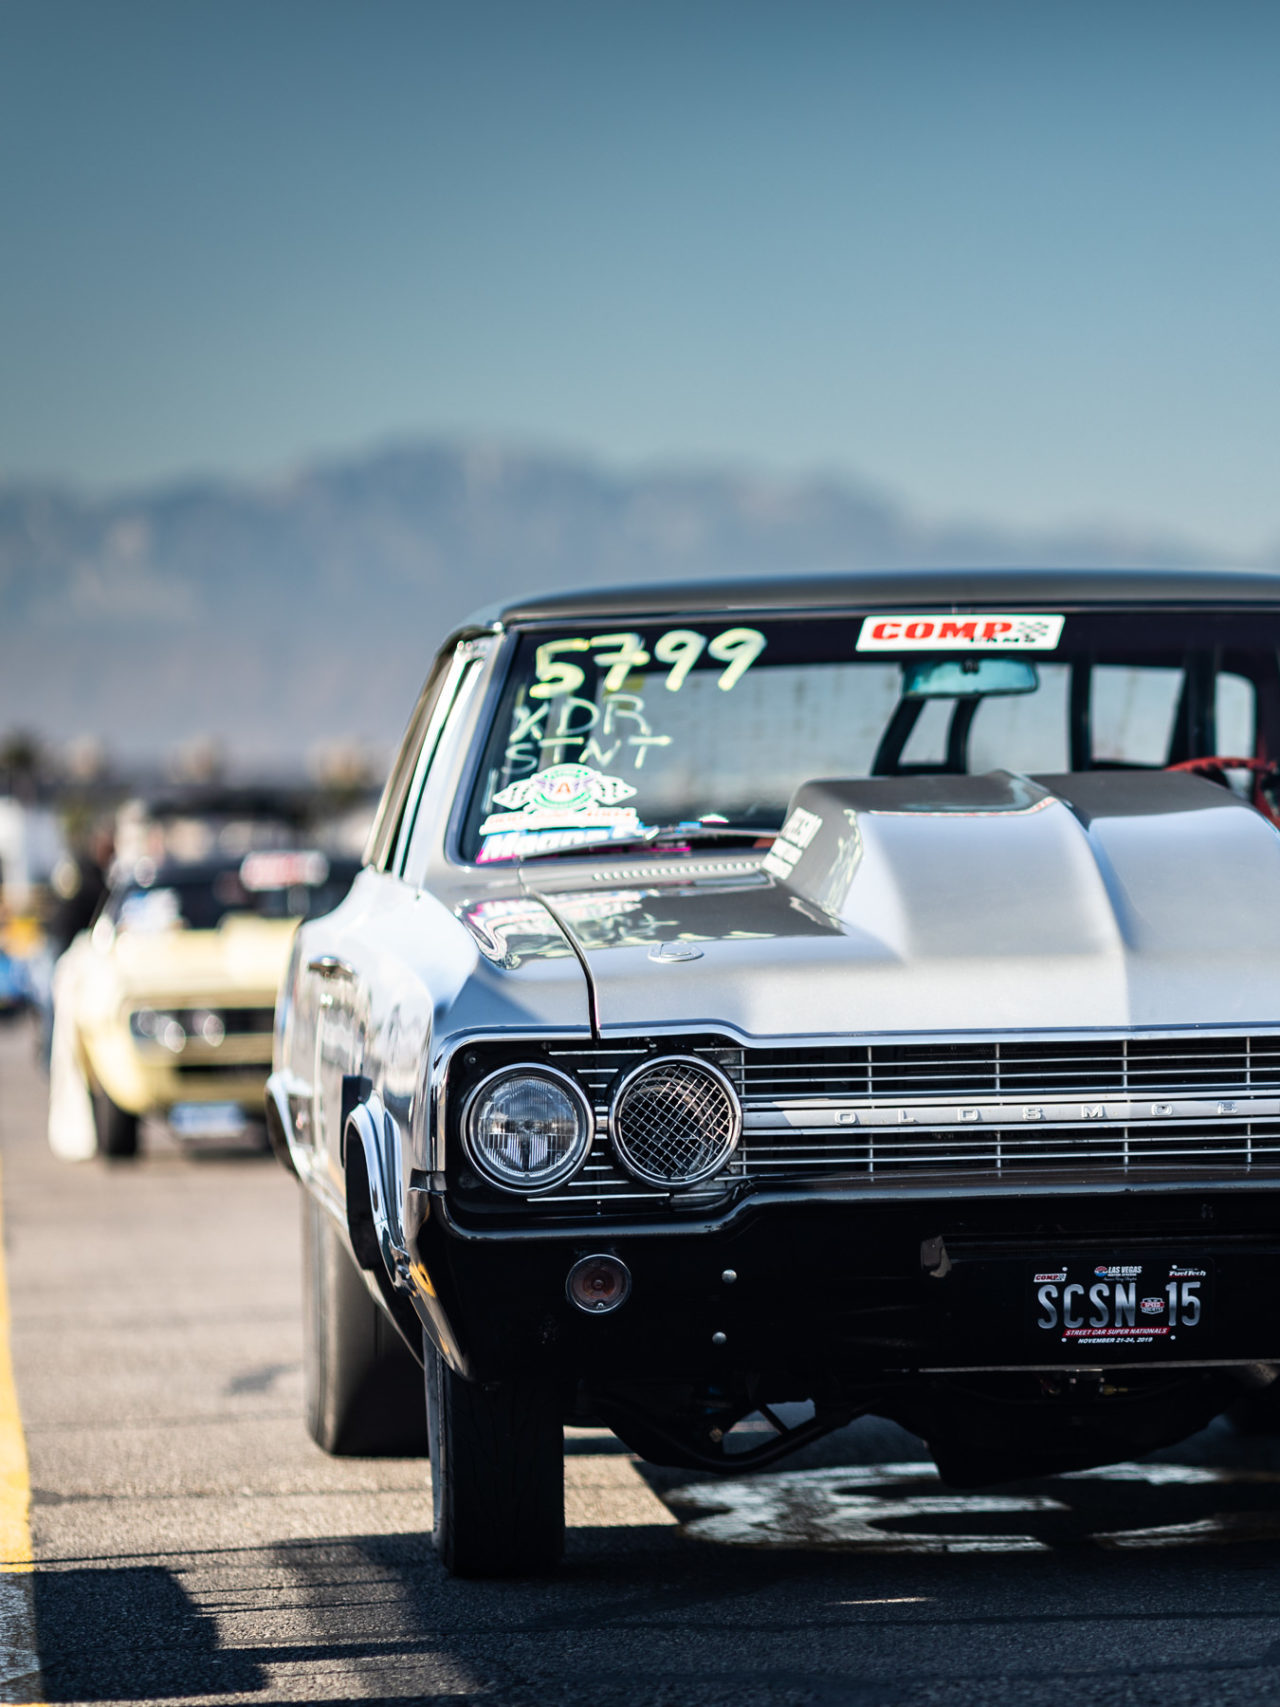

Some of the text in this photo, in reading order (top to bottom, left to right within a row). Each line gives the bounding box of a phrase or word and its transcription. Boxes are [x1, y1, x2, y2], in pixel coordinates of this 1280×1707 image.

[872, 622, 1013, 640] COMP
[529, 627, 767, 699] 5799
[1108, 1265, 1143, 1274] LAS VEGAS
[1037, 1281, 1201, 1329] SCSN 15
[1107, 1328, 1129, 1336] SUPER
[1130, 1327, 1168, 1335] NATIONALS
